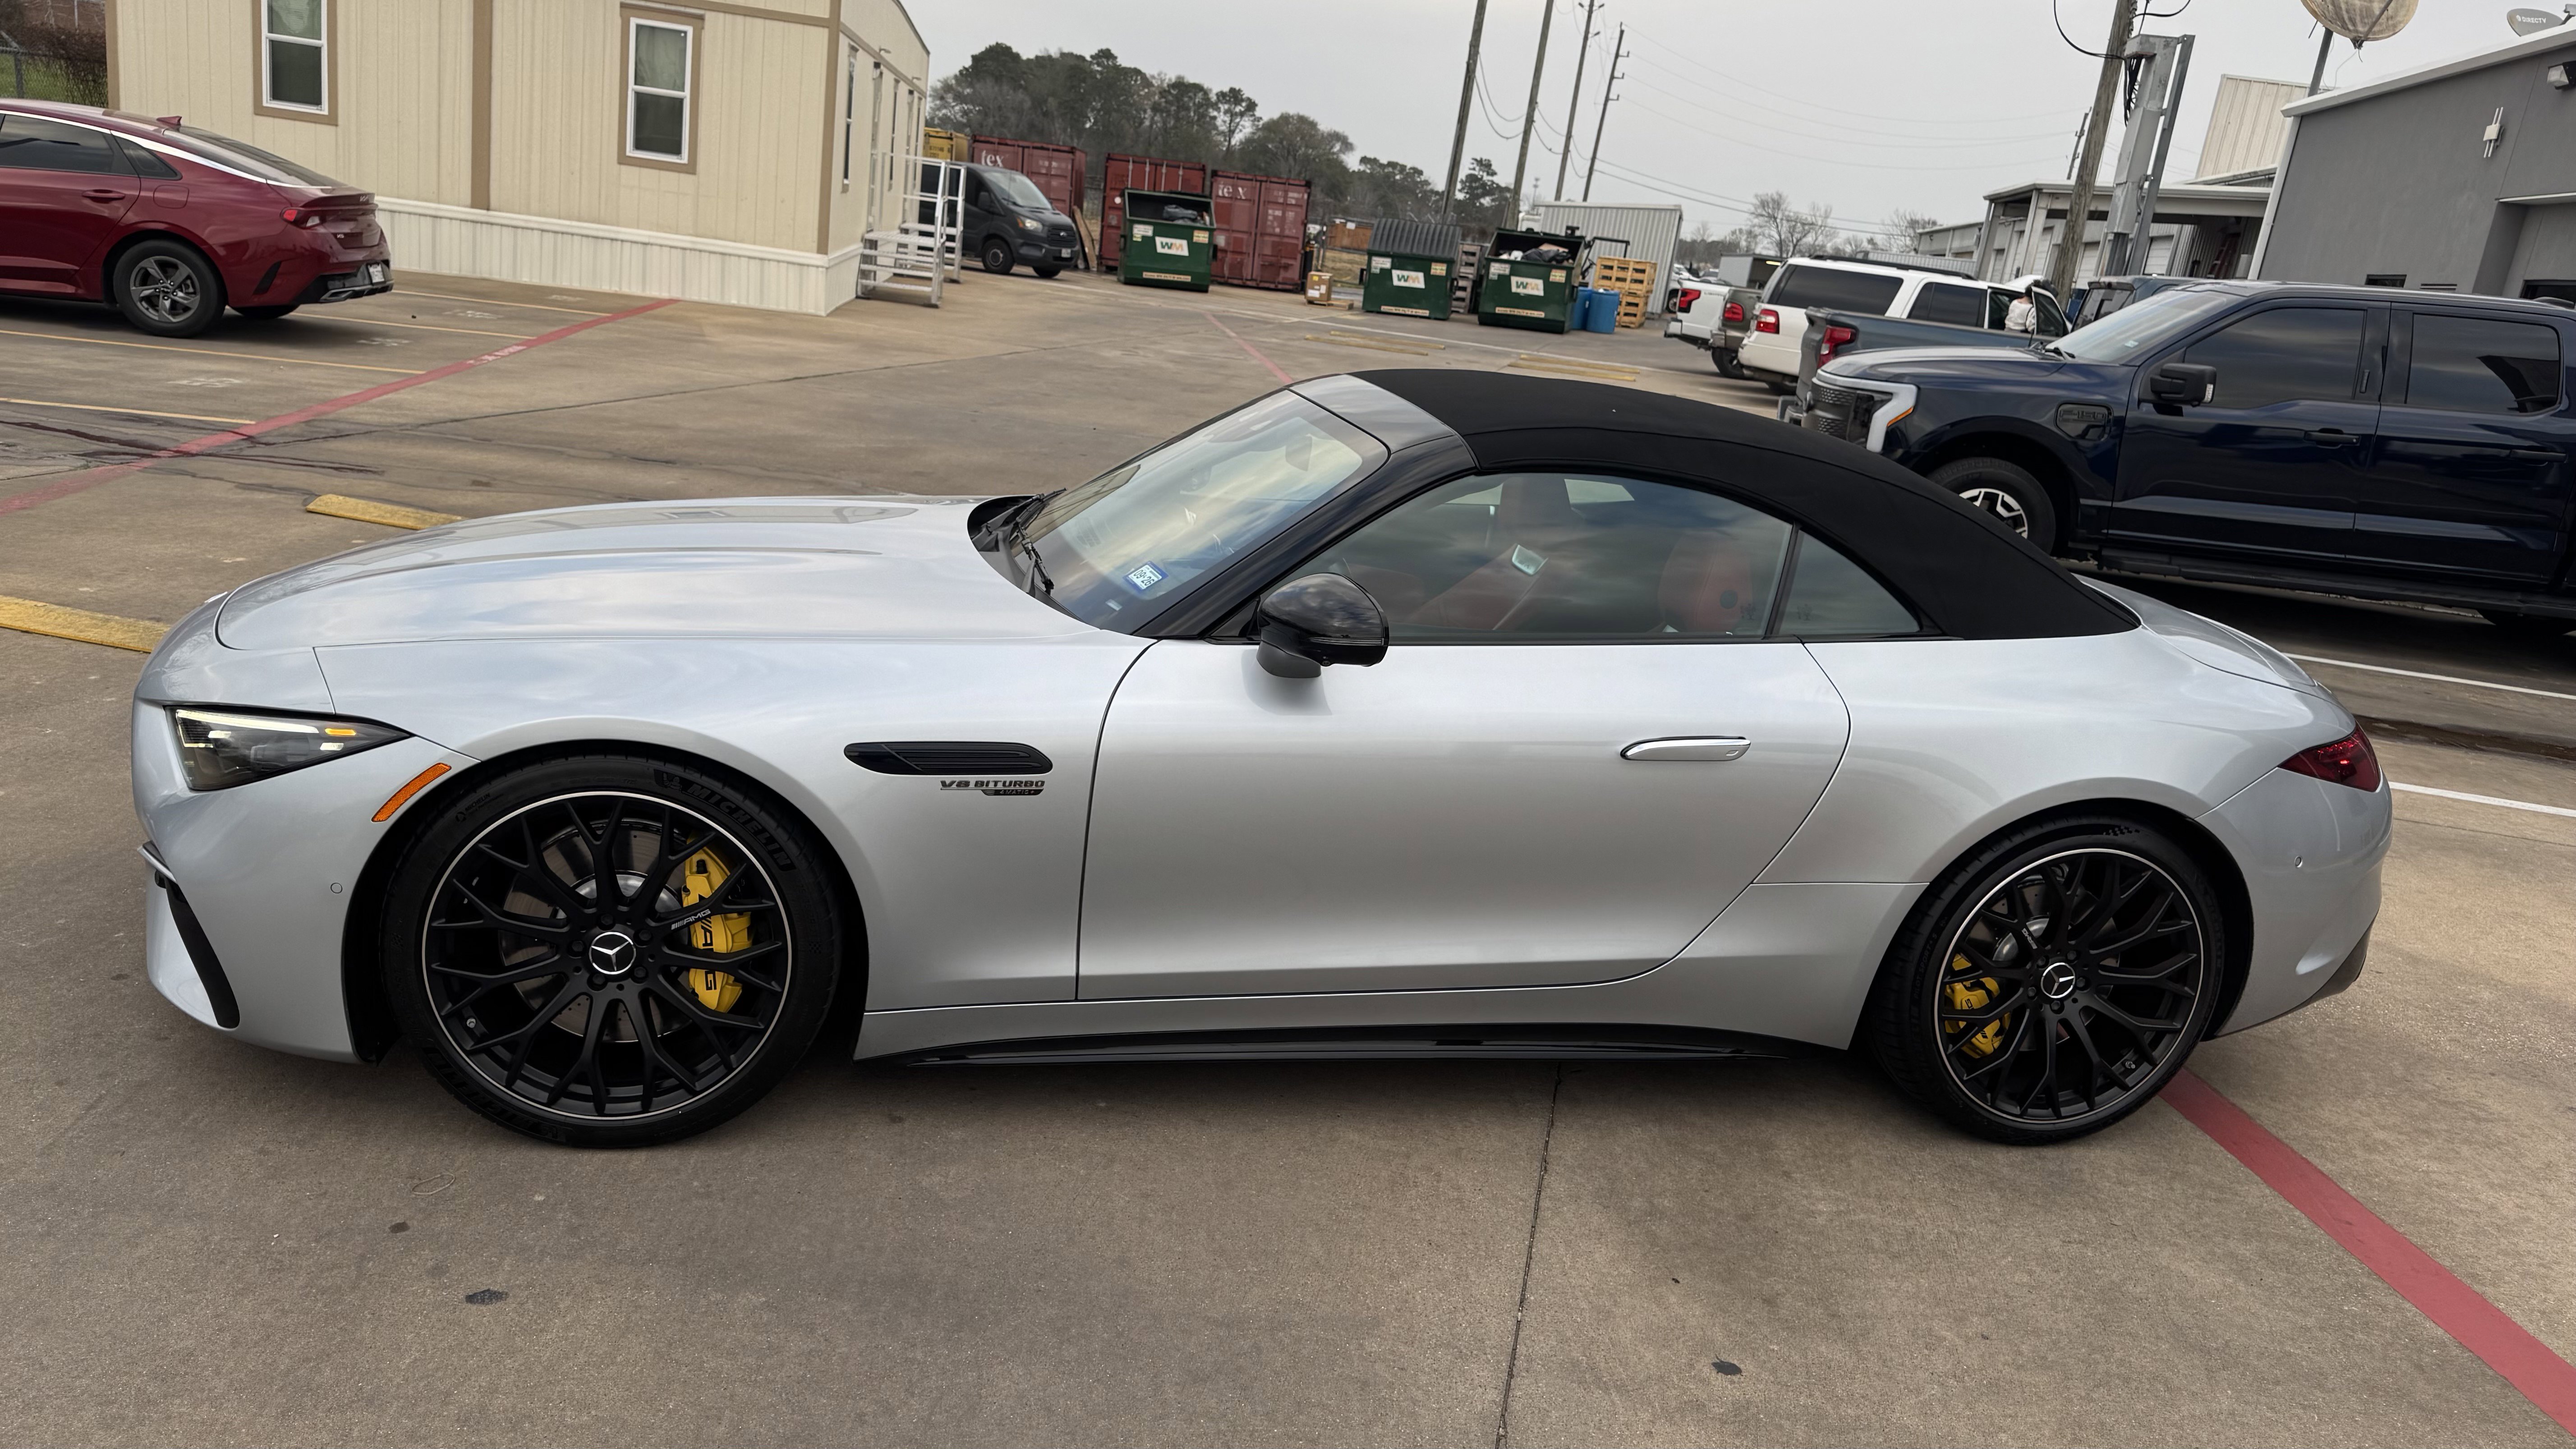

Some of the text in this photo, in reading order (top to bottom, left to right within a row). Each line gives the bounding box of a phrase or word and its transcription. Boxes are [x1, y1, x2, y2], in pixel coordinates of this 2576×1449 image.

[981, 149, 1005, 168] tex
[1160, 241, 1184, 252] WM
[1397, 274, 1421, 284] WM
[1515, 280, 1540, 291] WM
[687, 784, 792, 867] MICHELIN
